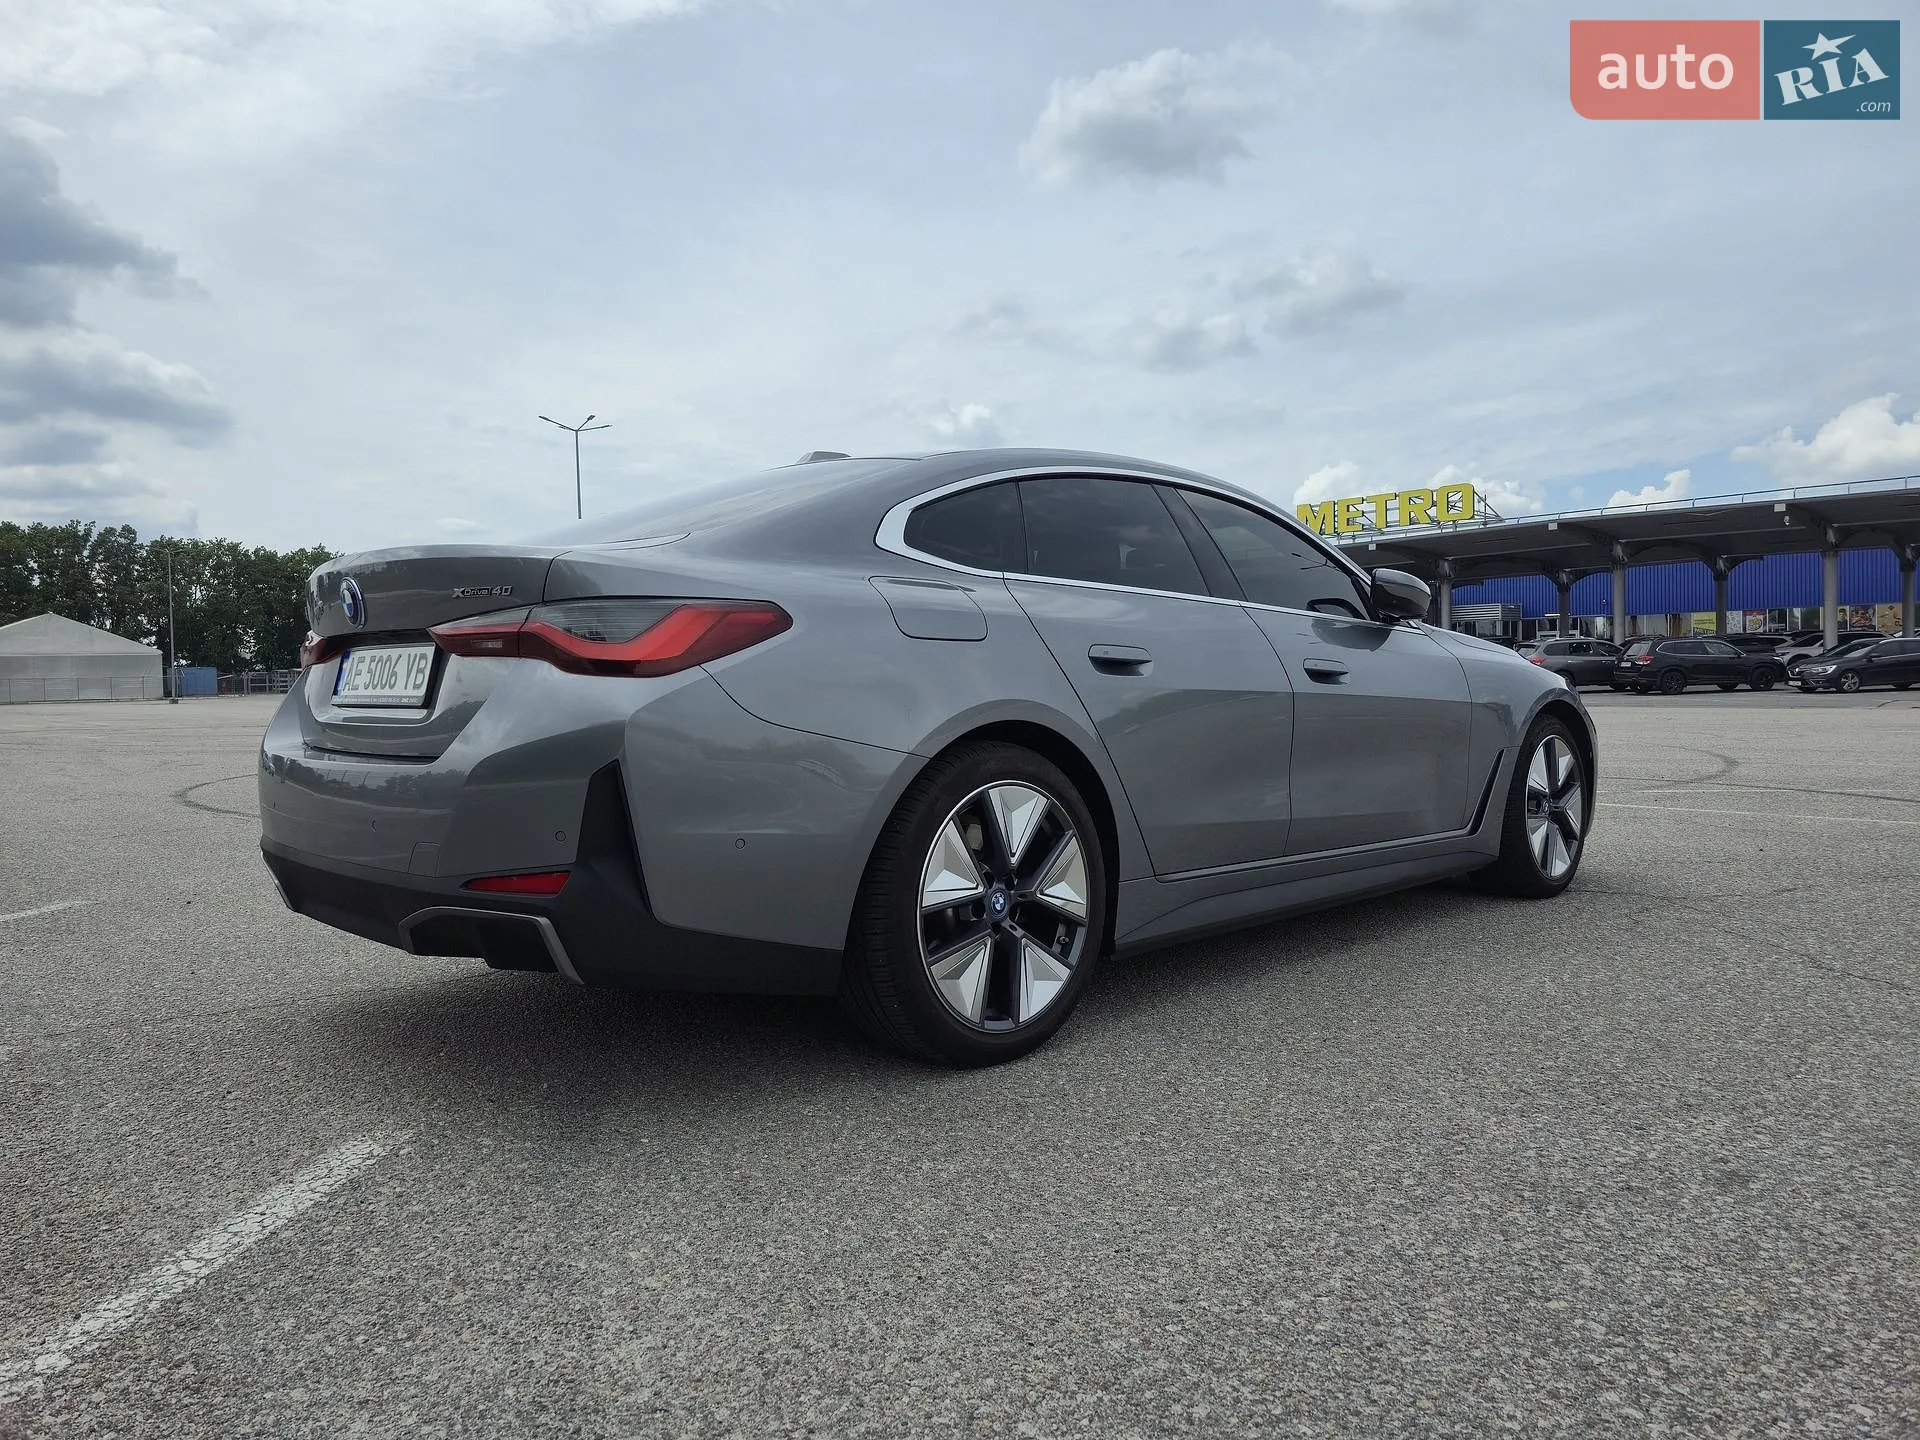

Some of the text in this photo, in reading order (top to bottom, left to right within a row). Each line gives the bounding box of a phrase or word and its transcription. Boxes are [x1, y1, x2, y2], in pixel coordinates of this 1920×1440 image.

[1296, 483, 1475, 535] METRO
[492, 585, 512, 596] 40
[342, 653, 428, 691] AE 5006 YB
